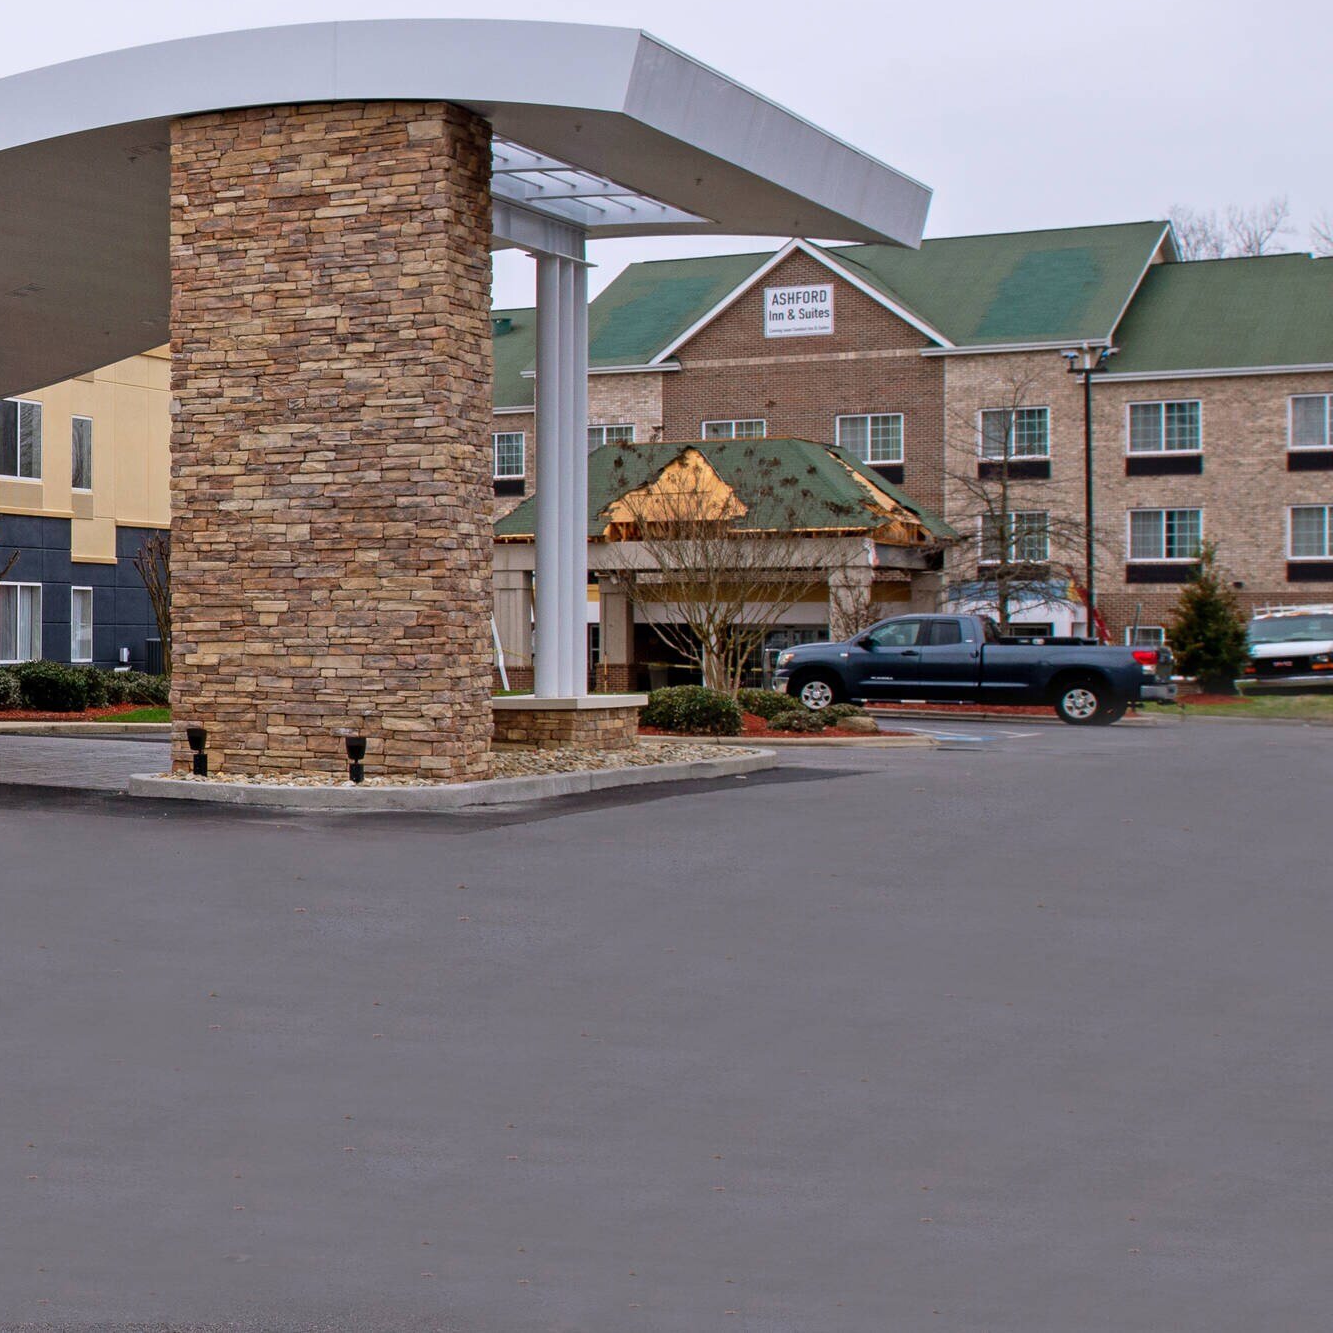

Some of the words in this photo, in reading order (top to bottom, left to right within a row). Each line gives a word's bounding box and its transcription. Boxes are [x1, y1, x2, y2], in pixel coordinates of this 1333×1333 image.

[772, 290, 827, 306] ASHFORD
[769, 310, 784, 321] Inn
[787, 309, 795, 320] &
[799, 308, 830, 319] Suites
